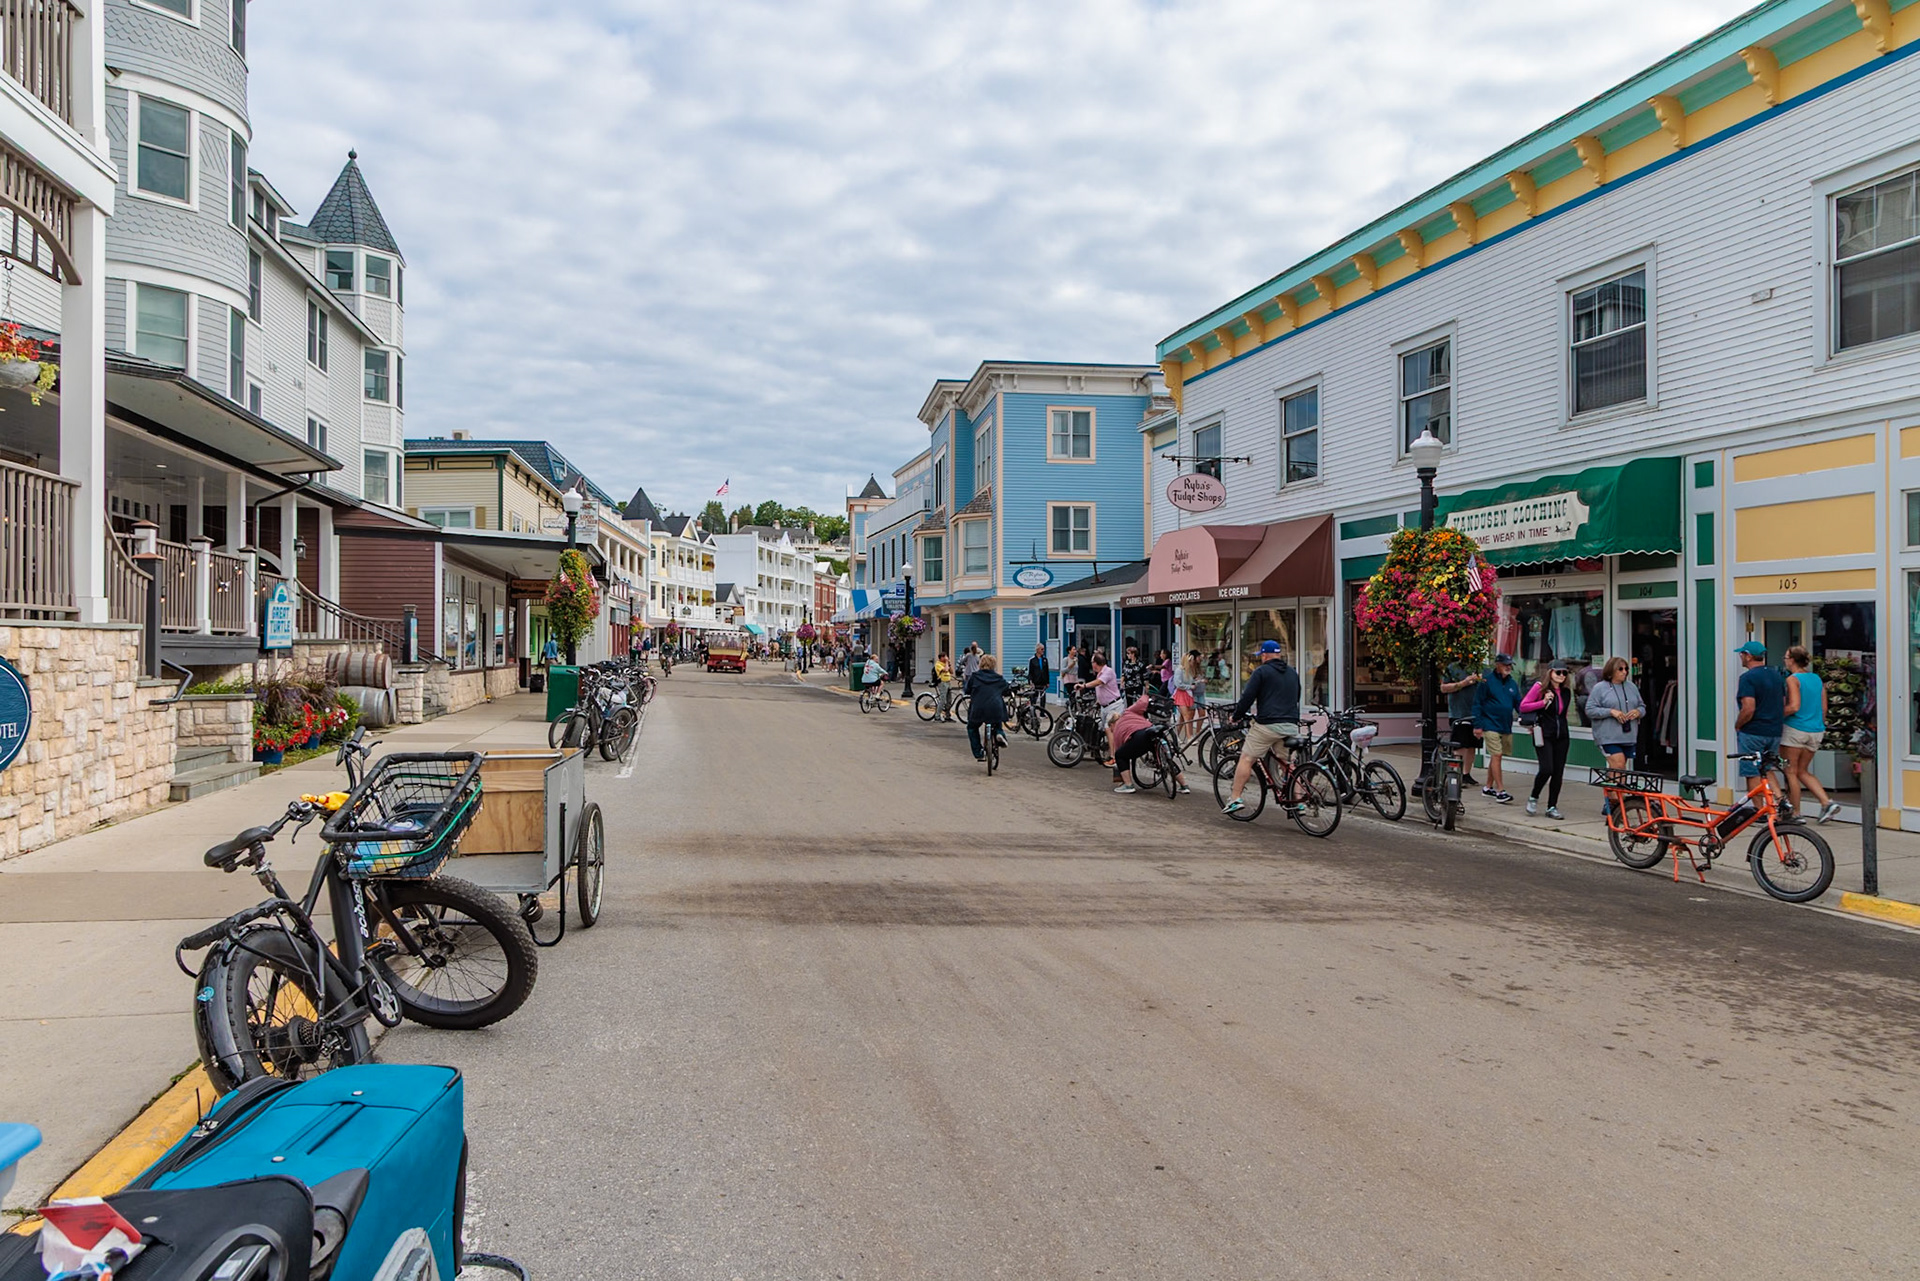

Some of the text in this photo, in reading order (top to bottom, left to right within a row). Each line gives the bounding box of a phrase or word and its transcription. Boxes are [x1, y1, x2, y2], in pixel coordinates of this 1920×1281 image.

[1184, 478, 1211, 493] Ryba's
[1172, 490, 1222, 505] Fudge Shops
[1513, 499, 1567, 524] CLOTHING
[1493, 532, 1515, 543] WEAR
[1518, 530, 1526, 540] IN
[1540, 579, 1556, 588] 7463
[1779, 577, 1798, 590] 105
[1126, 586, 1249, 605] CARMEL CORN CHOCOLATES ICE CREAM
[1639, 586, 1652, 597] 104
[272, 606, 290, 619] GREAT
[270, 620, 290, 633] TURTLE
